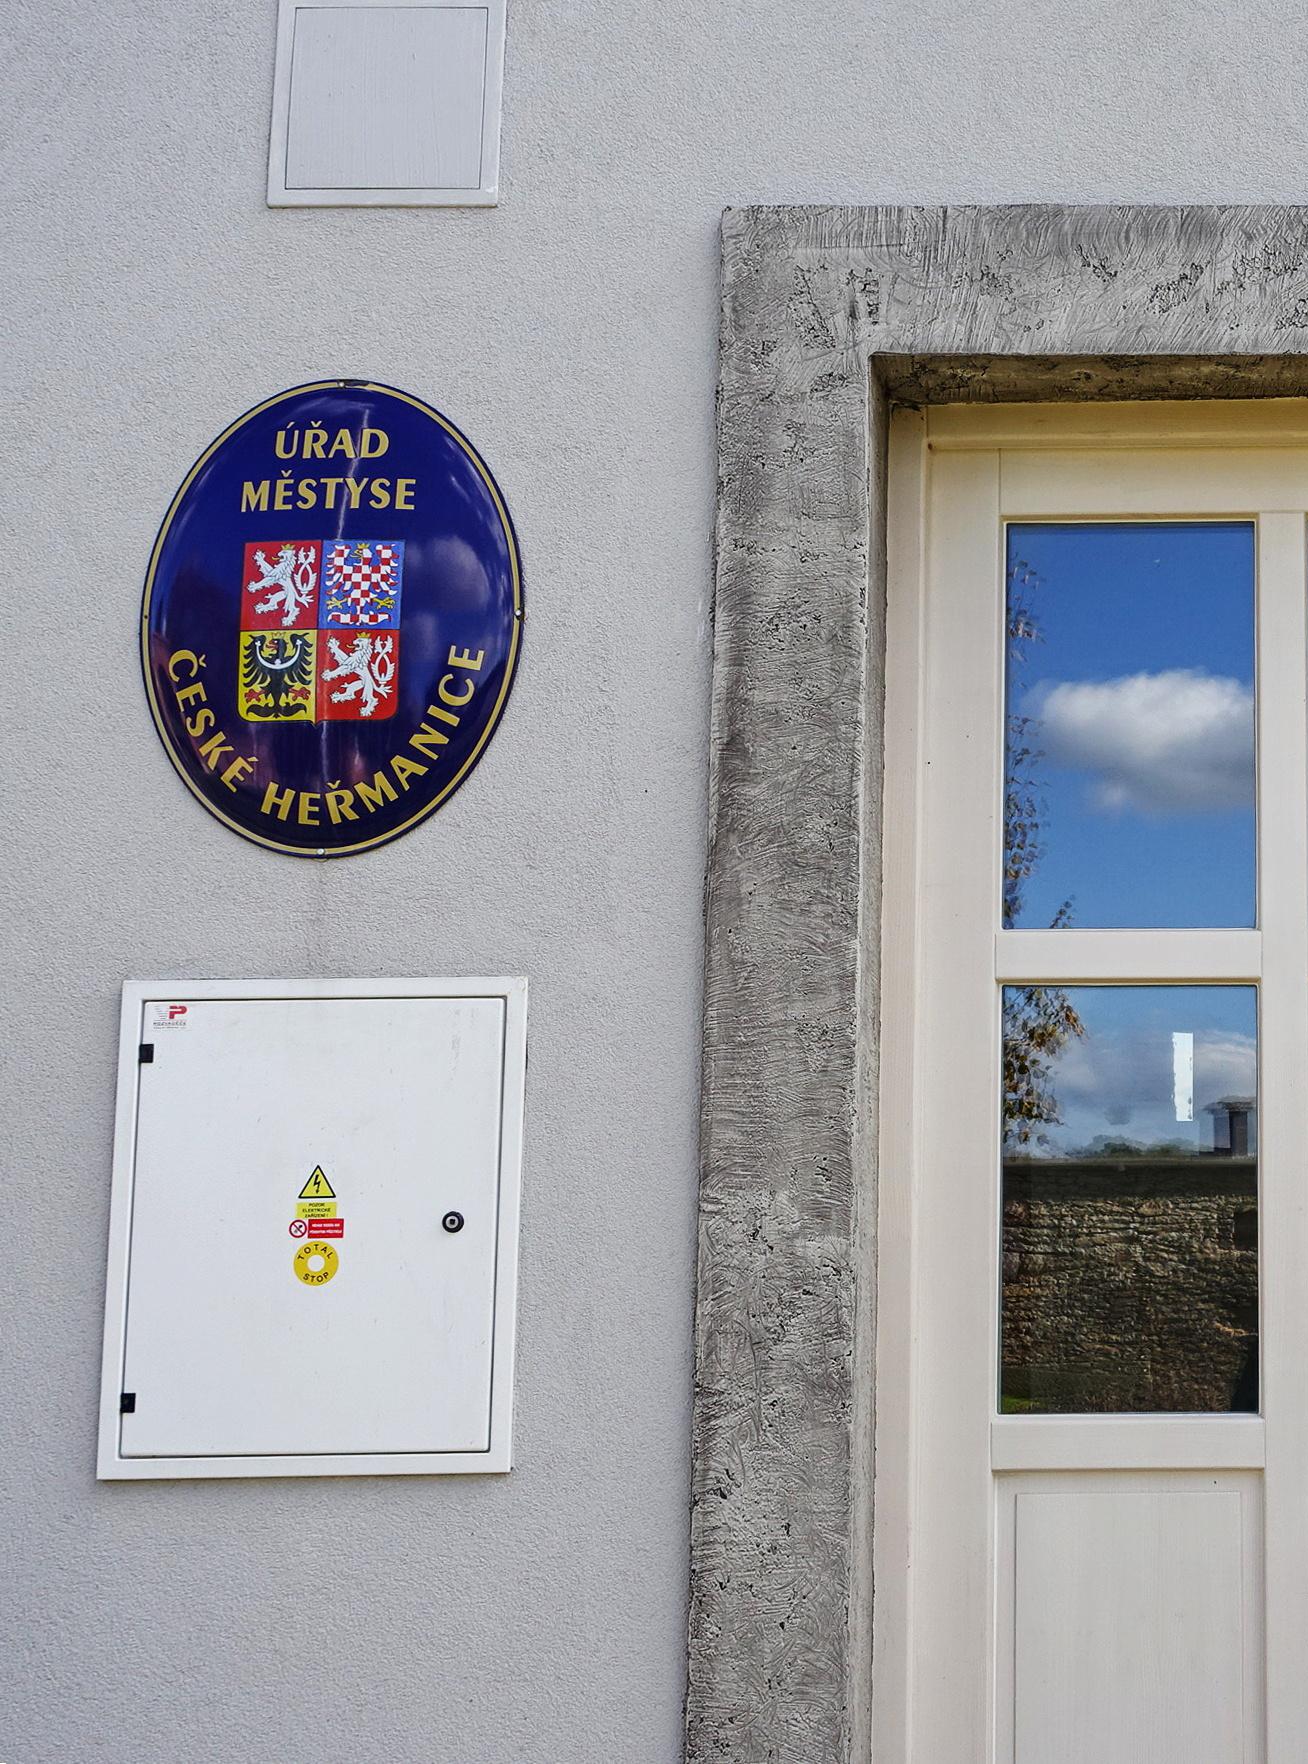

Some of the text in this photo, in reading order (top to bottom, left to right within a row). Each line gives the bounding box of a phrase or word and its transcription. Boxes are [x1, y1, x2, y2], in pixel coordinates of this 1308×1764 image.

[274, 421, 390, 459] ÚŘAD
[240, 469, 416, 513] MĚSTYSE
[168, 644, 485, 826] ČESKÉ HEŘMANICE
[297, 1243, 334, 1260] TOTAL
[303, 1272, 329, 1282] STOP
